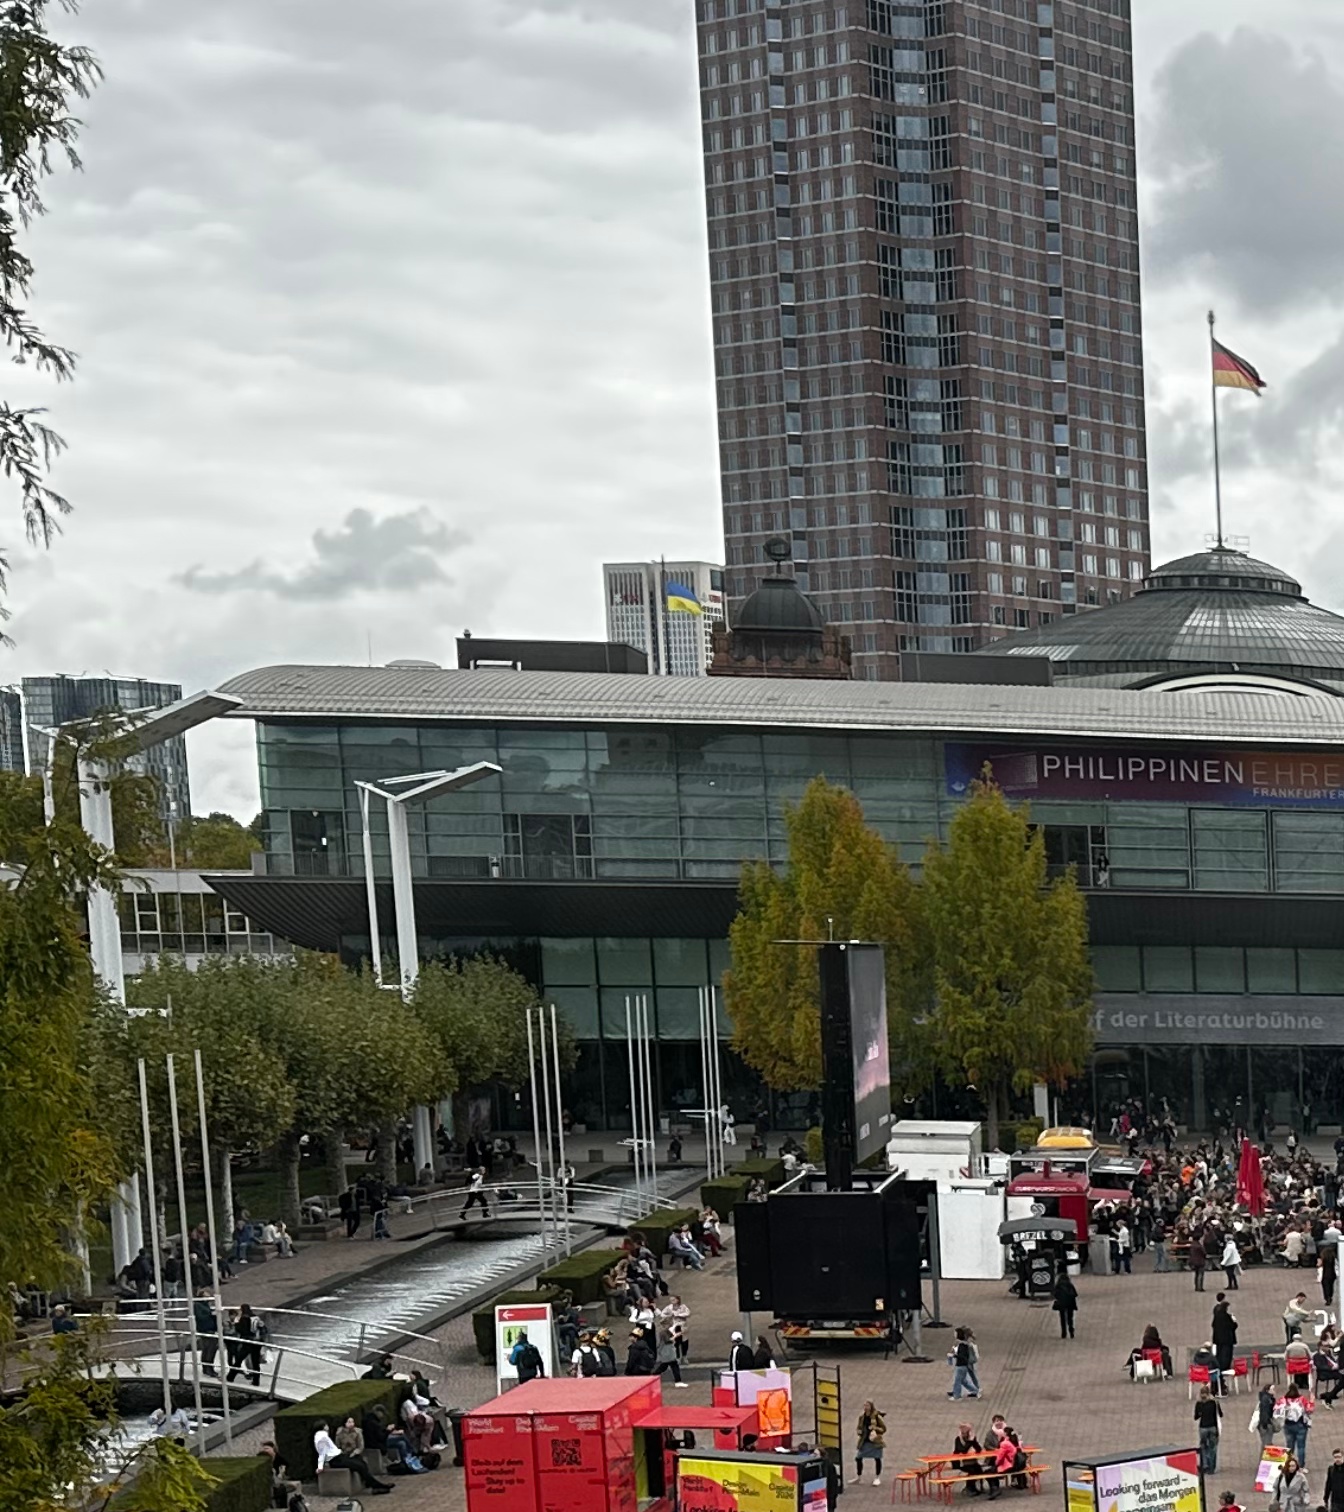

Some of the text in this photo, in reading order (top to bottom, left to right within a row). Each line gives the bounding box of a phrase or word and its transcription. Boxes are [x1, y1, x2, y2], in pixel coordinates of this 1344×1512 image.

[1043, 755, 1244, 784] PHILIPPINEN
[1252, 787, 1344, 800] FRANKFURTER
[1110, 1011, 1148, 1028] der
[1155, 1010, 1324, 1030] Literaturbühne
[1099, 1483, 1141, 1499] Looking
[1142, 1474, 1181, 1491] forward
[1138, 1486, 1197, 1504] das Morgen
